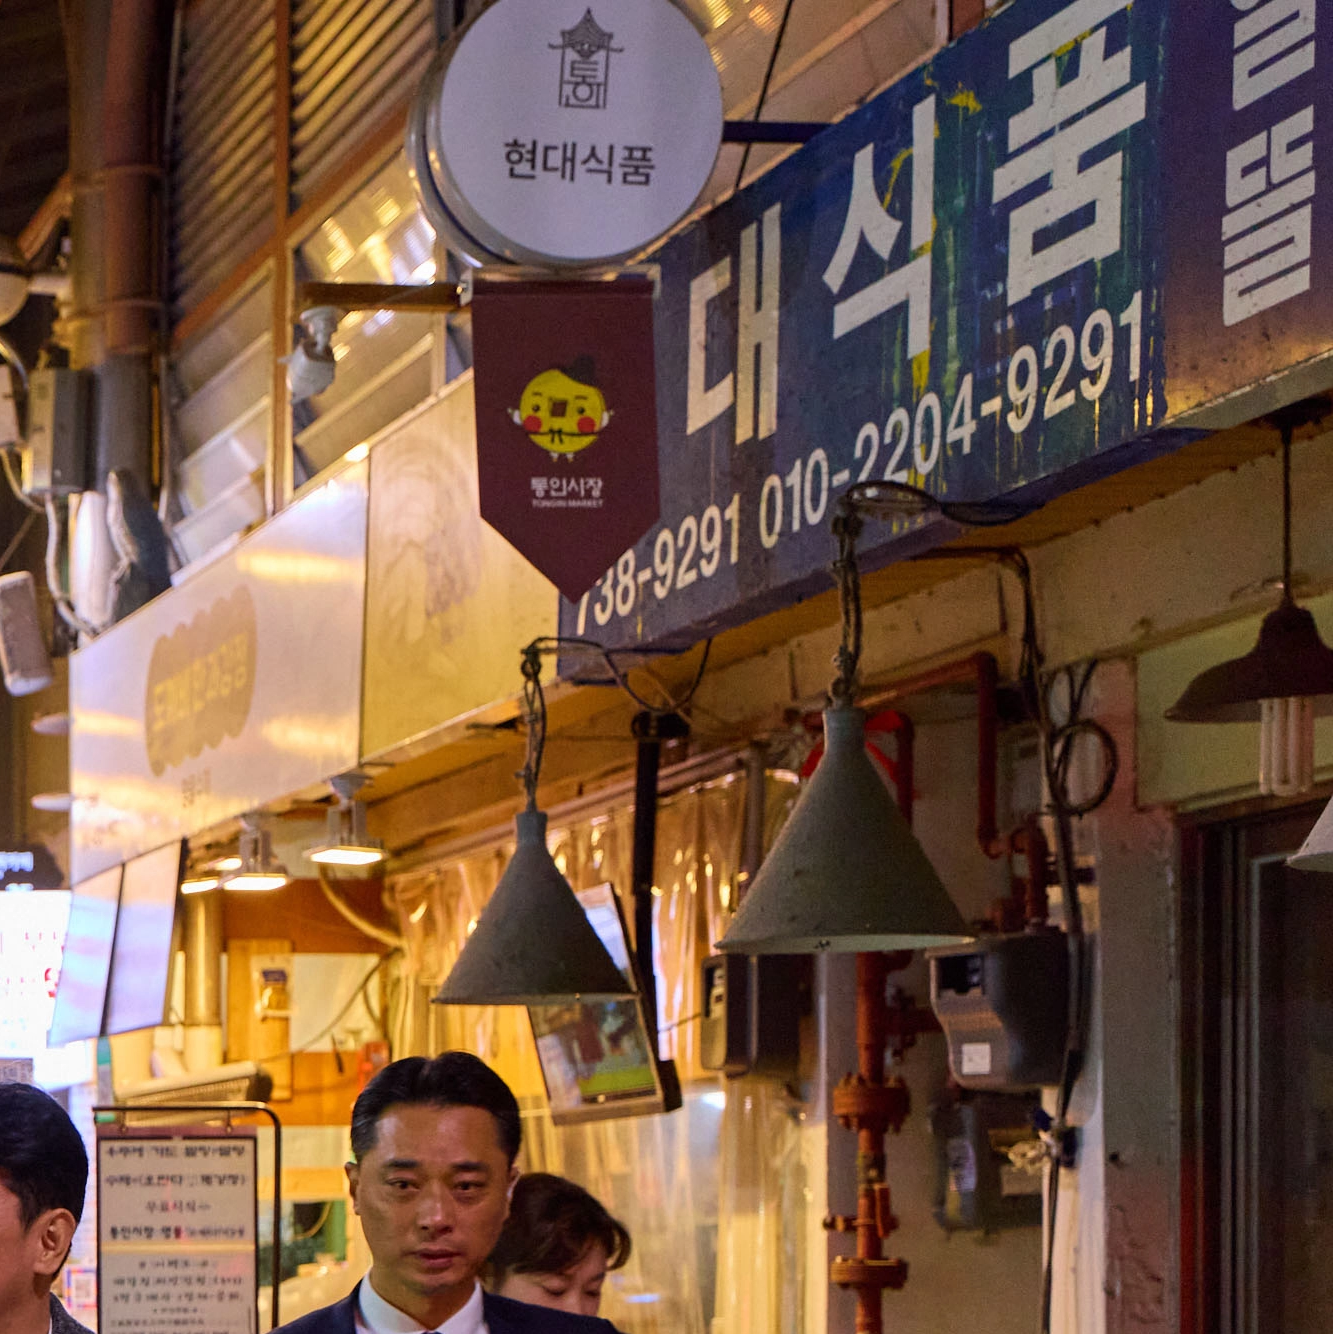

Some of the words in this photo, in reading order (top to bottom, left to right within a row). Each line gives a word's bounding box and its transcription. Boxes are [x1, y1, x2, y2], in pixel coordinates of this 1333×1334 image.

[503, 138, 655, 186] 현대식품
[758, 290, 1145, 550] 010-2204-9291
[531, 477, 603, 498] 통인시장
